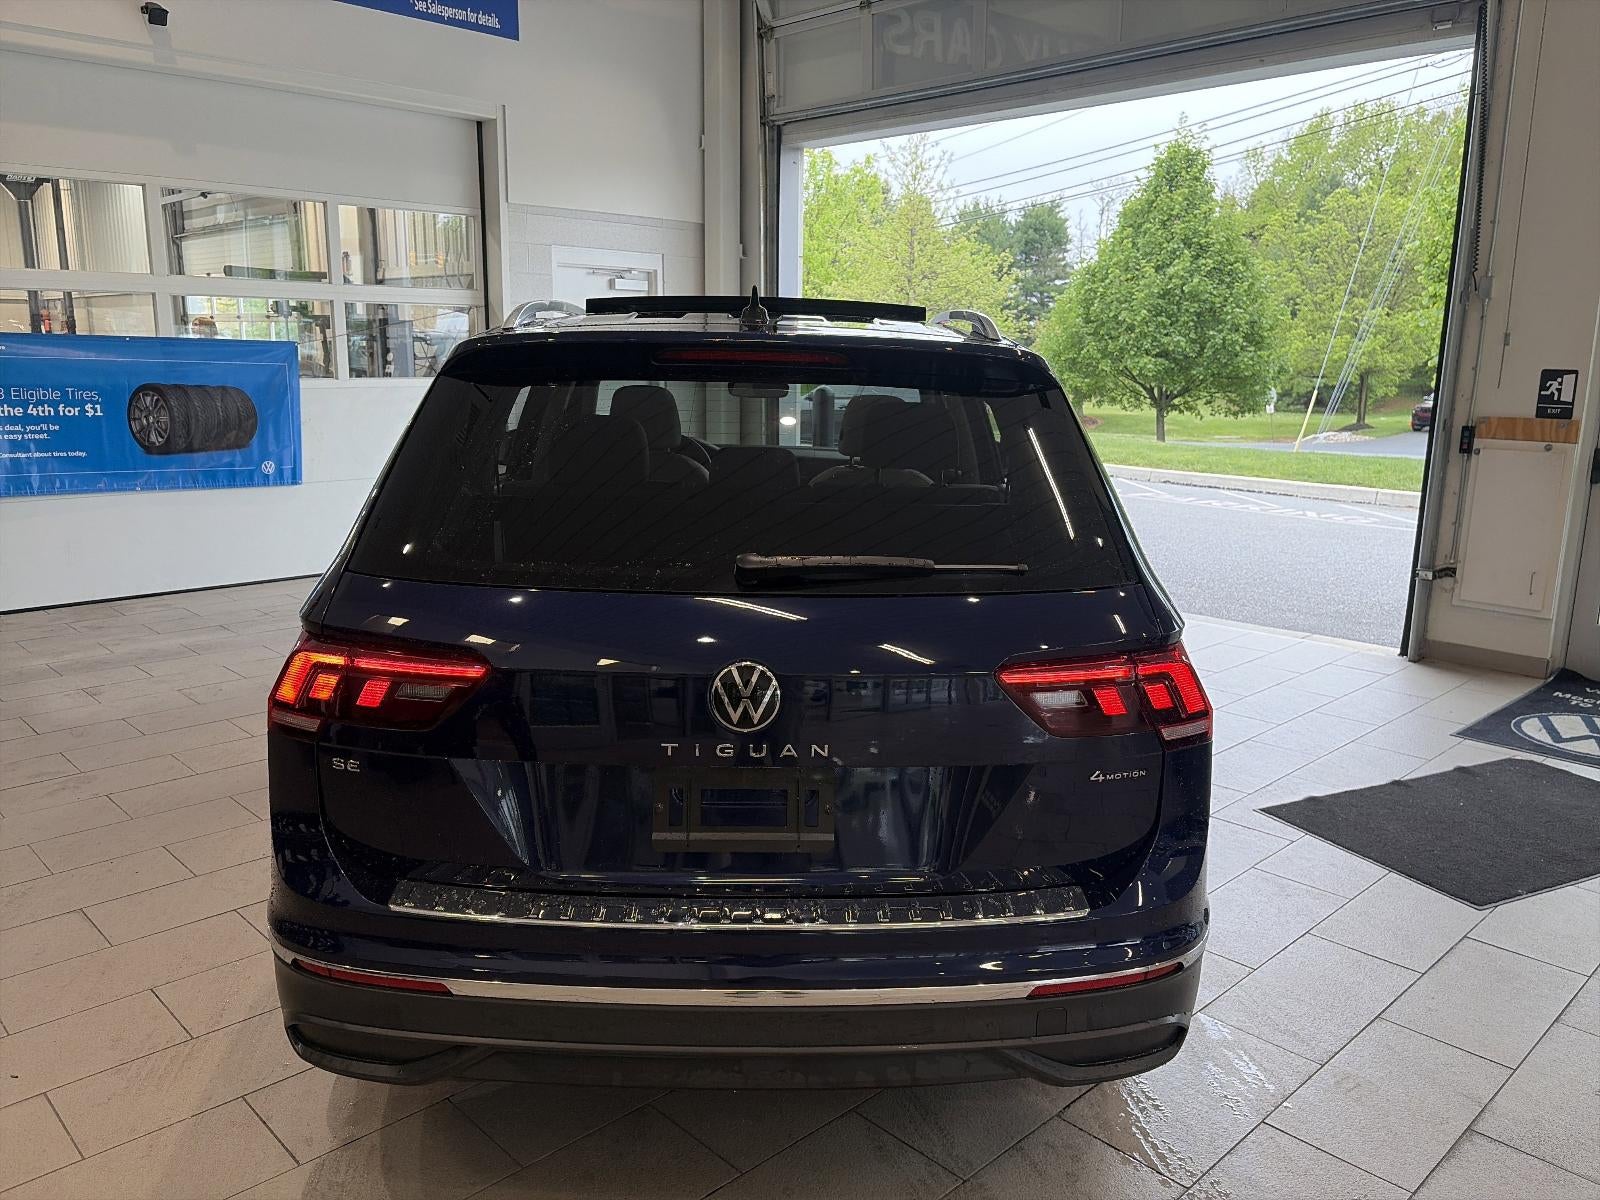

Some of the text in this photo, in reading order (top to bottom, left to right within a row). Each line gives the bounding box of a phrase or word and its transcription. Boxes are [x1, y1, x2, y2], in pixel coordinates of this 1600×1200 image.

[414, 0, 501, 29] See Salesperson for details.
[10, 387, 61, 403] Eligible
[66, 387, 102, 402] Tires,
[0, 403, 103, 417] the 4th for $1
[26, 424, 48, 432] you'll
[660, 743, 828, 758] TIGUAN
[332, 757, 361, 773] SE
[1089, 769, 1147, 783] 4MOTION
